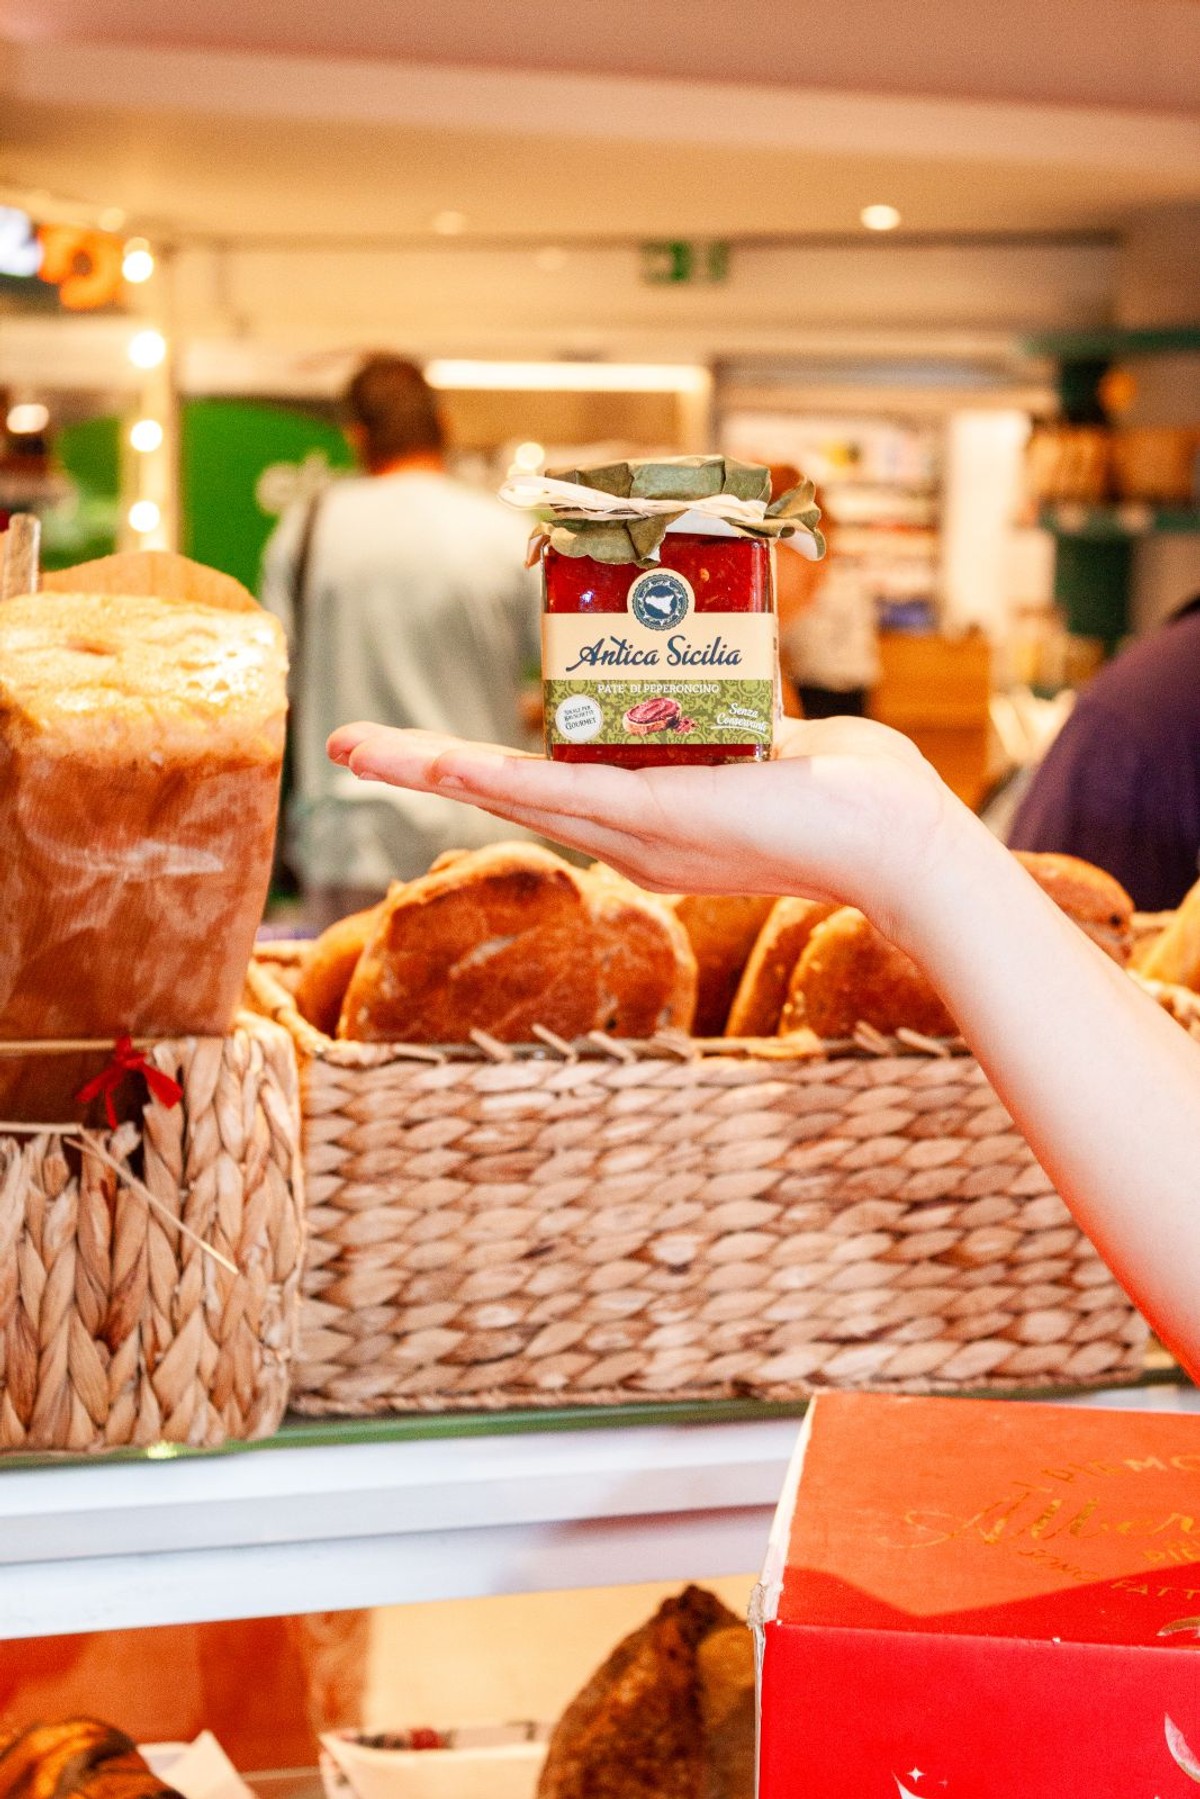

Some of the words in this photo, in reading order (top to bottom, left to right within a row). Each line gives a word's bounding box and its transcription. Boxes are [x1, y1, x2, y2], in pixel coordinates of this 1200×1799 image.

[565, 635, 660, 672] Antica
[666, 635, 742, 666] Sicilia
[629, 683, 642, 694] DI
[643, 683, 719, 694] PEPERONCINO
[729, 702, 759, 718] Senza
